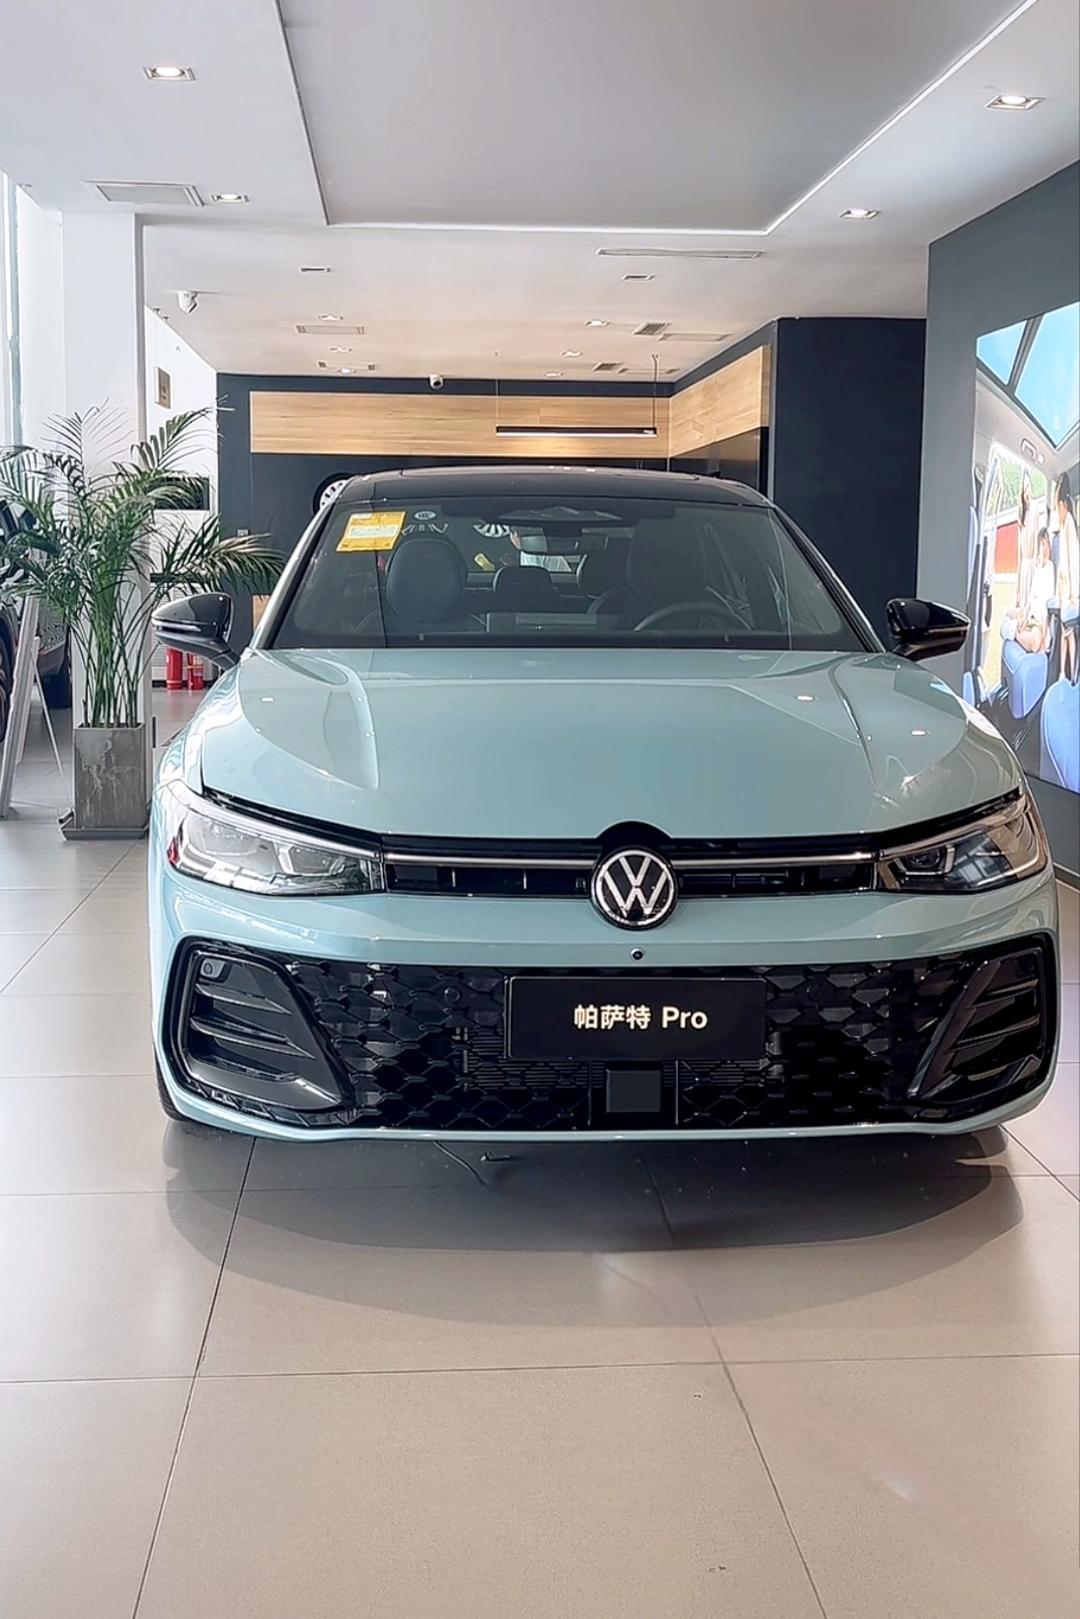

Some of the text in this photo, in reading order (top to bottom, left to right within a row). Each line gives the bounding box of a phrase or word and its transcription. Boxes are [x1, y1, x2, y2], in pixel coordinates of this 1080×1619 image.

[573, 1004, 708, 1029] 帕萨特 Pro
